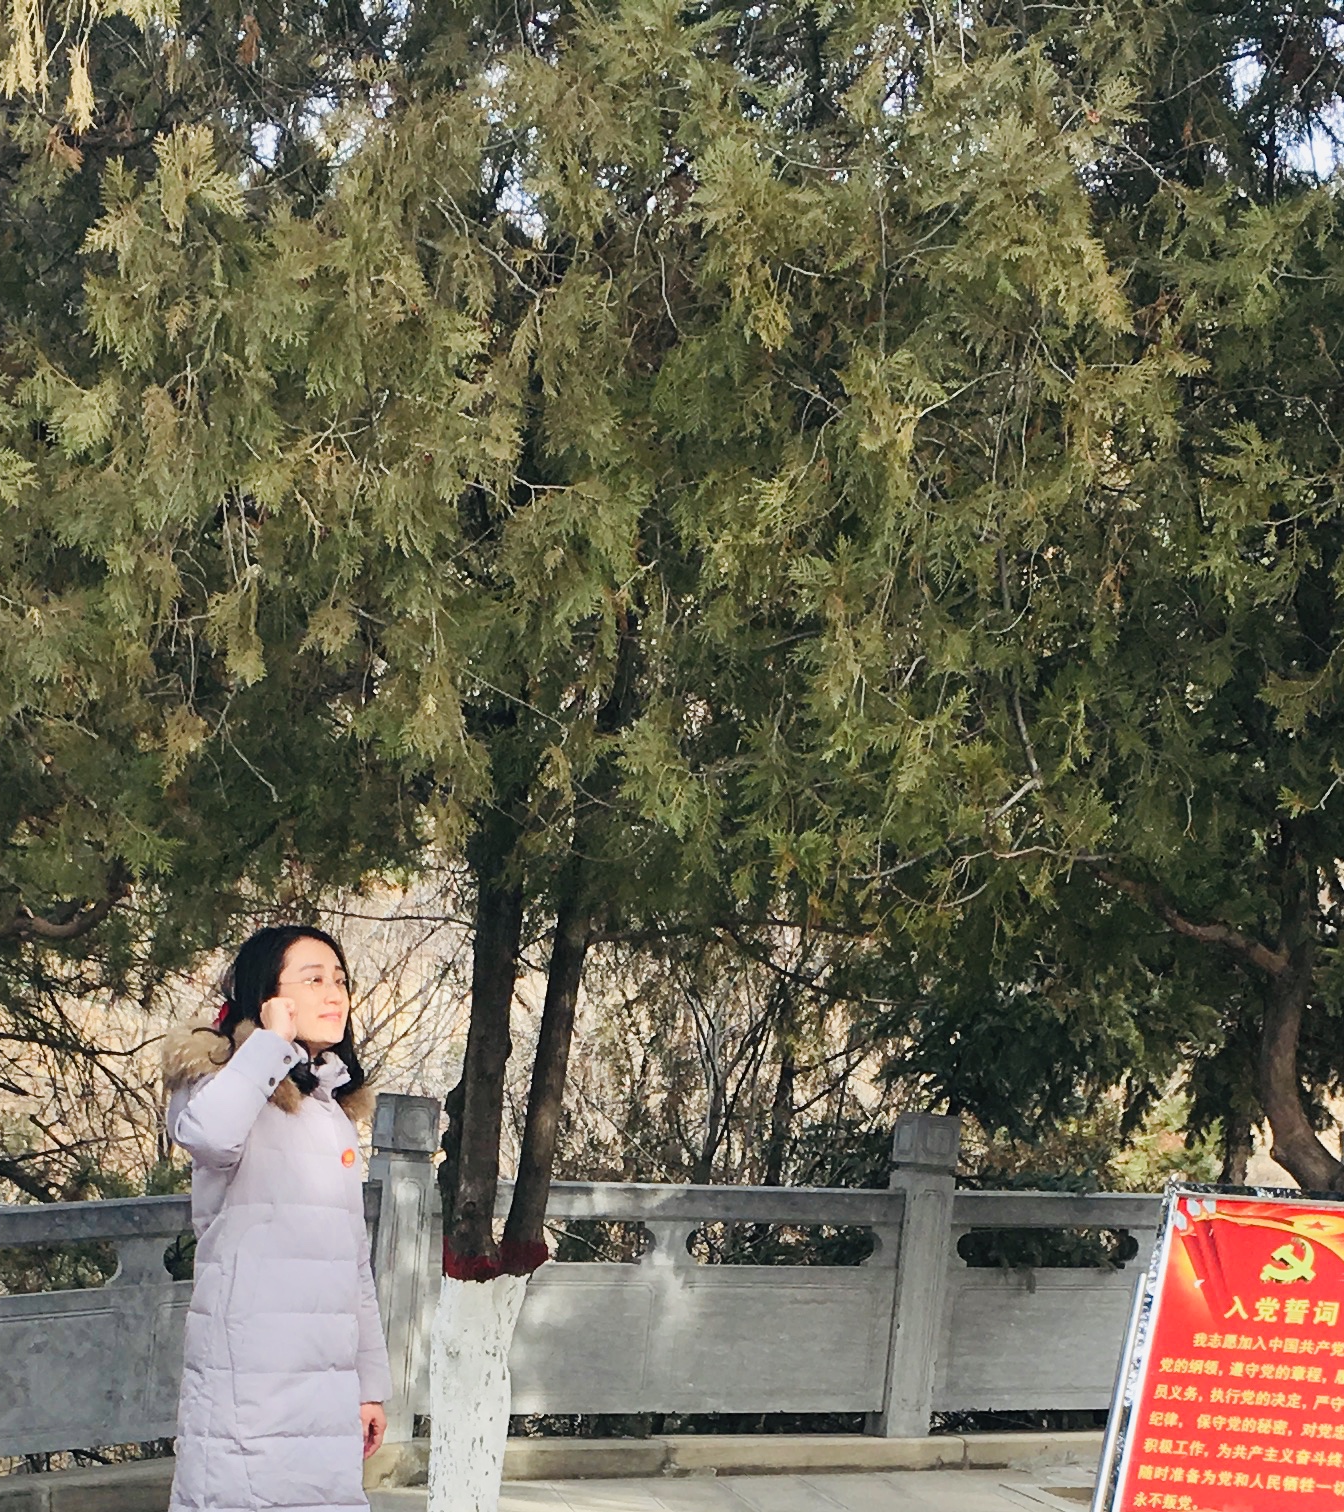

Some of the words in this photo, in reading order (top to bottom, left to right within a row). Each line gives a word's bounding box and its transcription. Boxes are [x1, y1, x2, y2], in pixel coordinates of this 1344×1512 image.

[1223, 1296, 1341, 1326] 入党誓词
[1133, 1492, 1199, 1512] 永不叛党。
